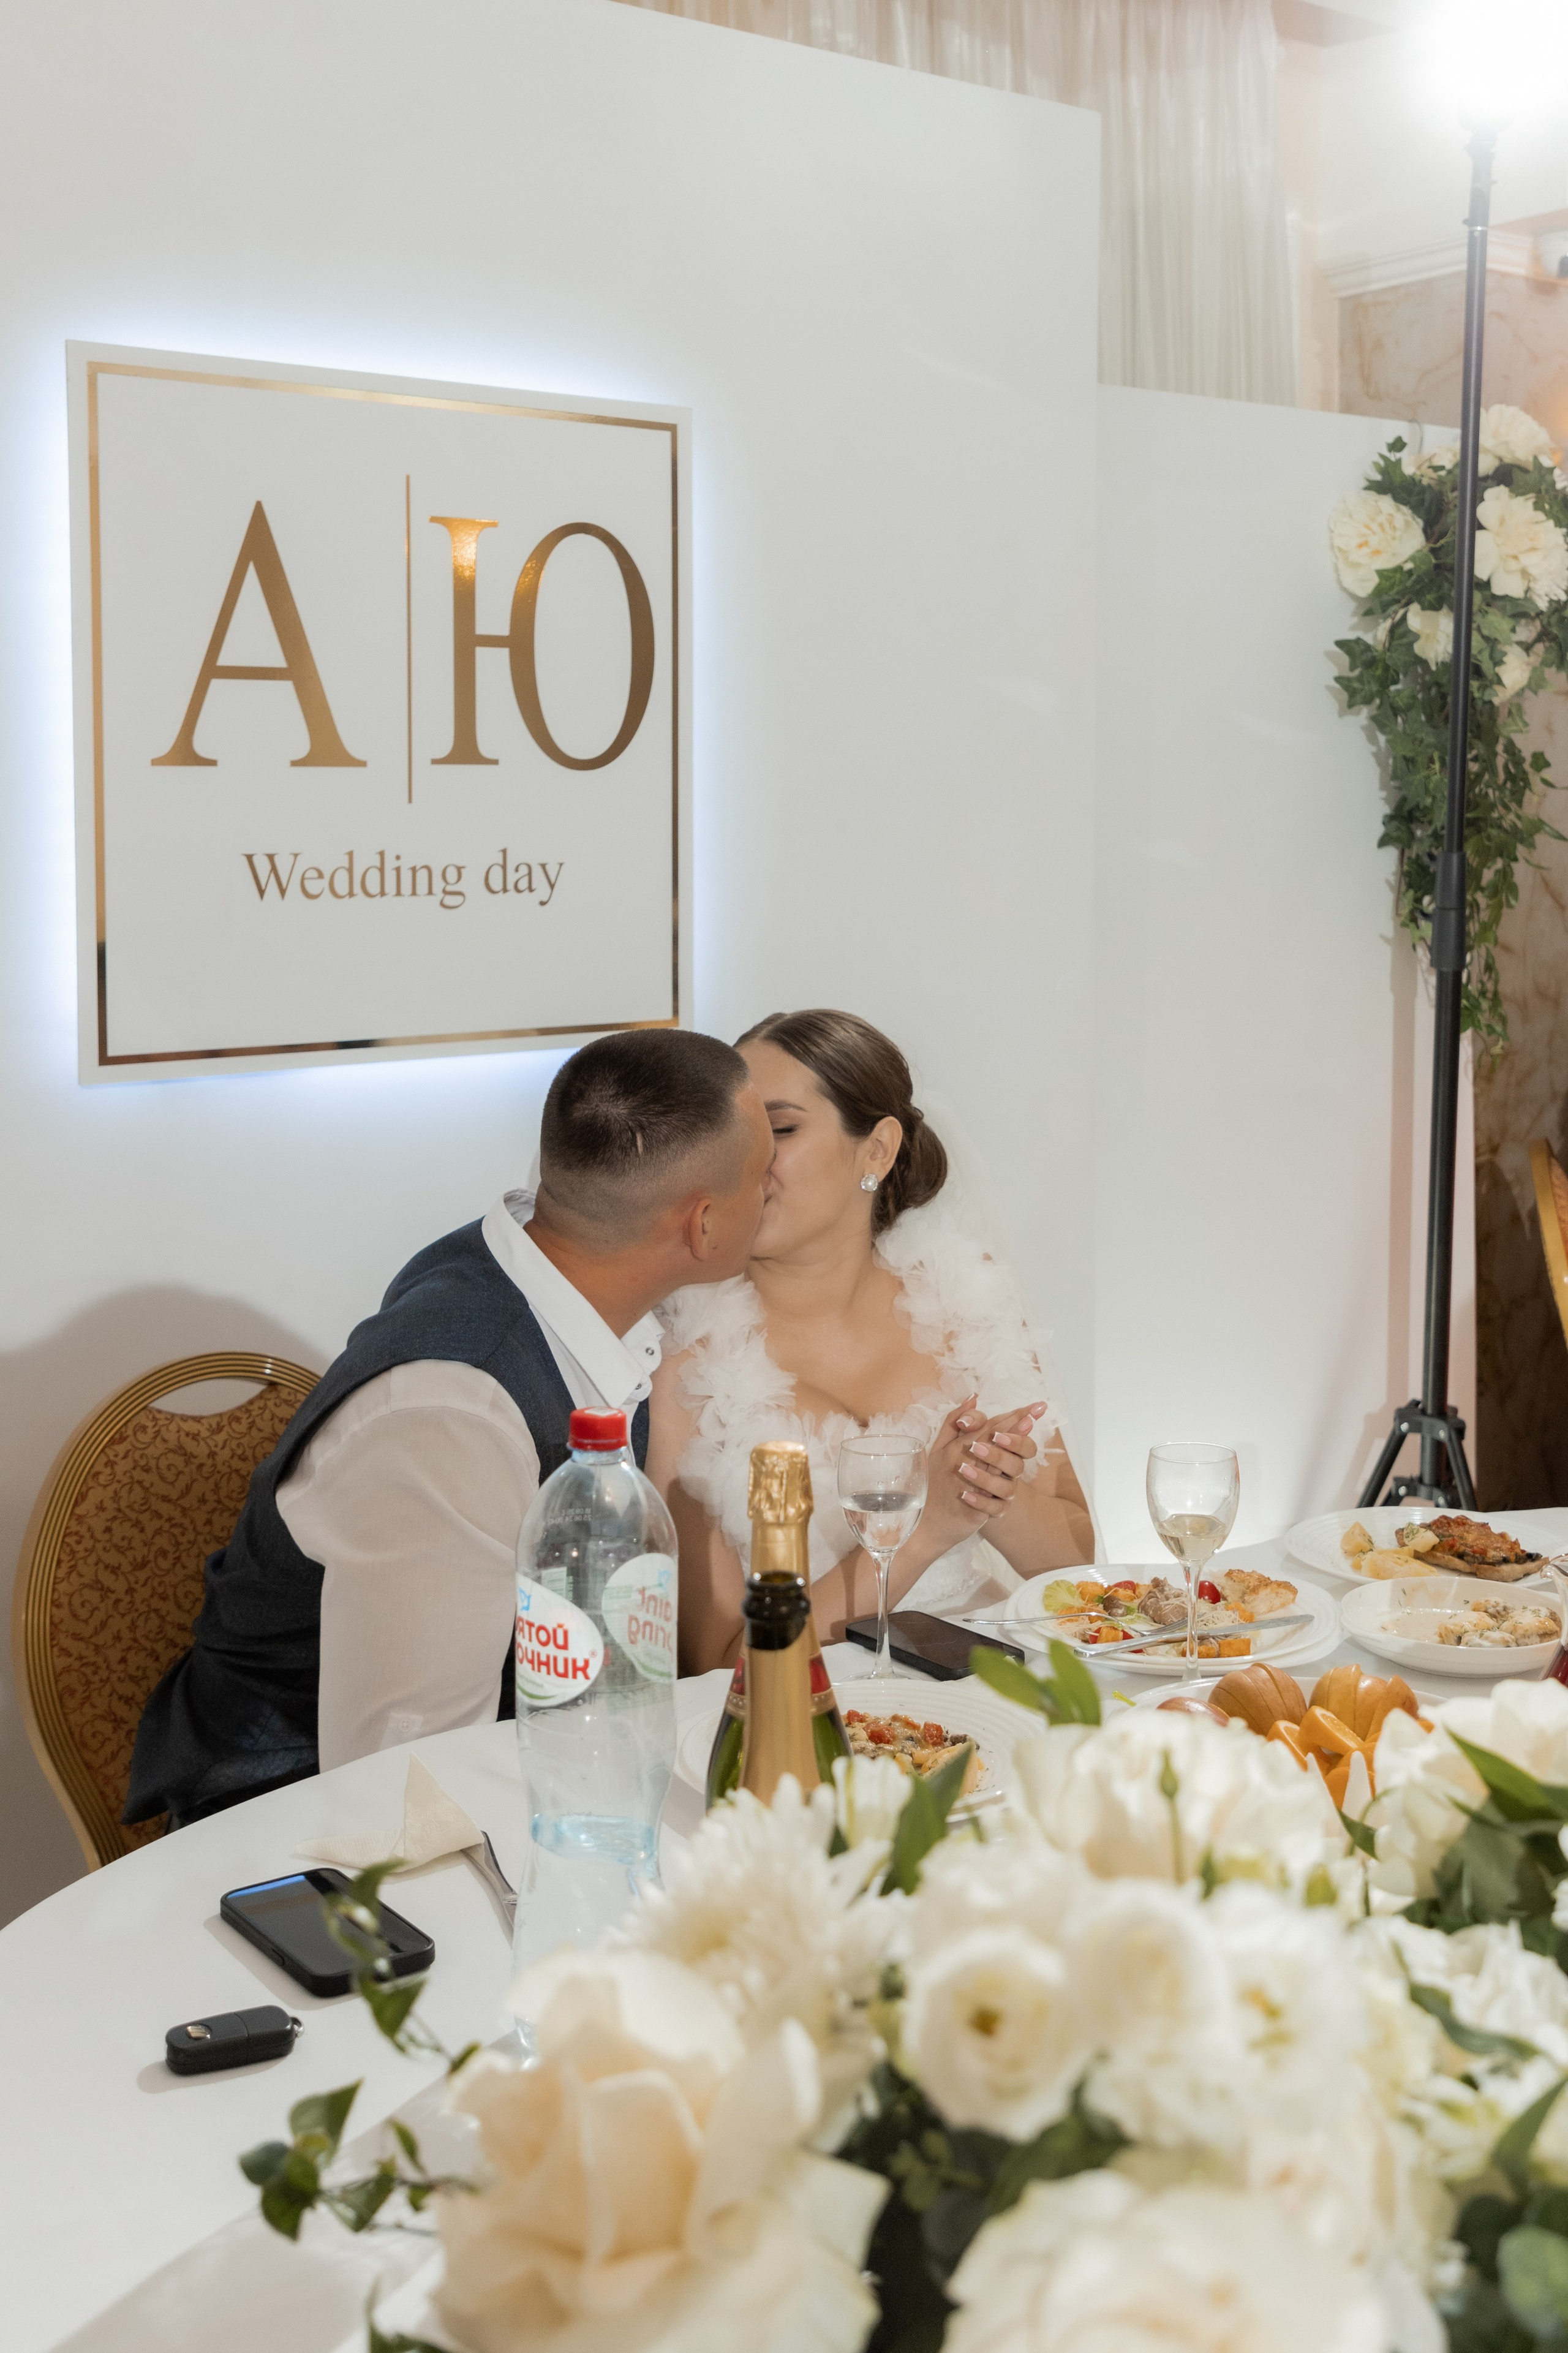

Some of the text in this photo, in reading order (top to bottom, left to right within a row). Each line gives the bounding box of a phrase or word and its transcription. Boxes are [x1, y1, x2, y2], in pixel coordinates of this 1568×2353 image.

[428, 516, 655, 771] Ю
[241, 847, 565, 910] Wedding day
